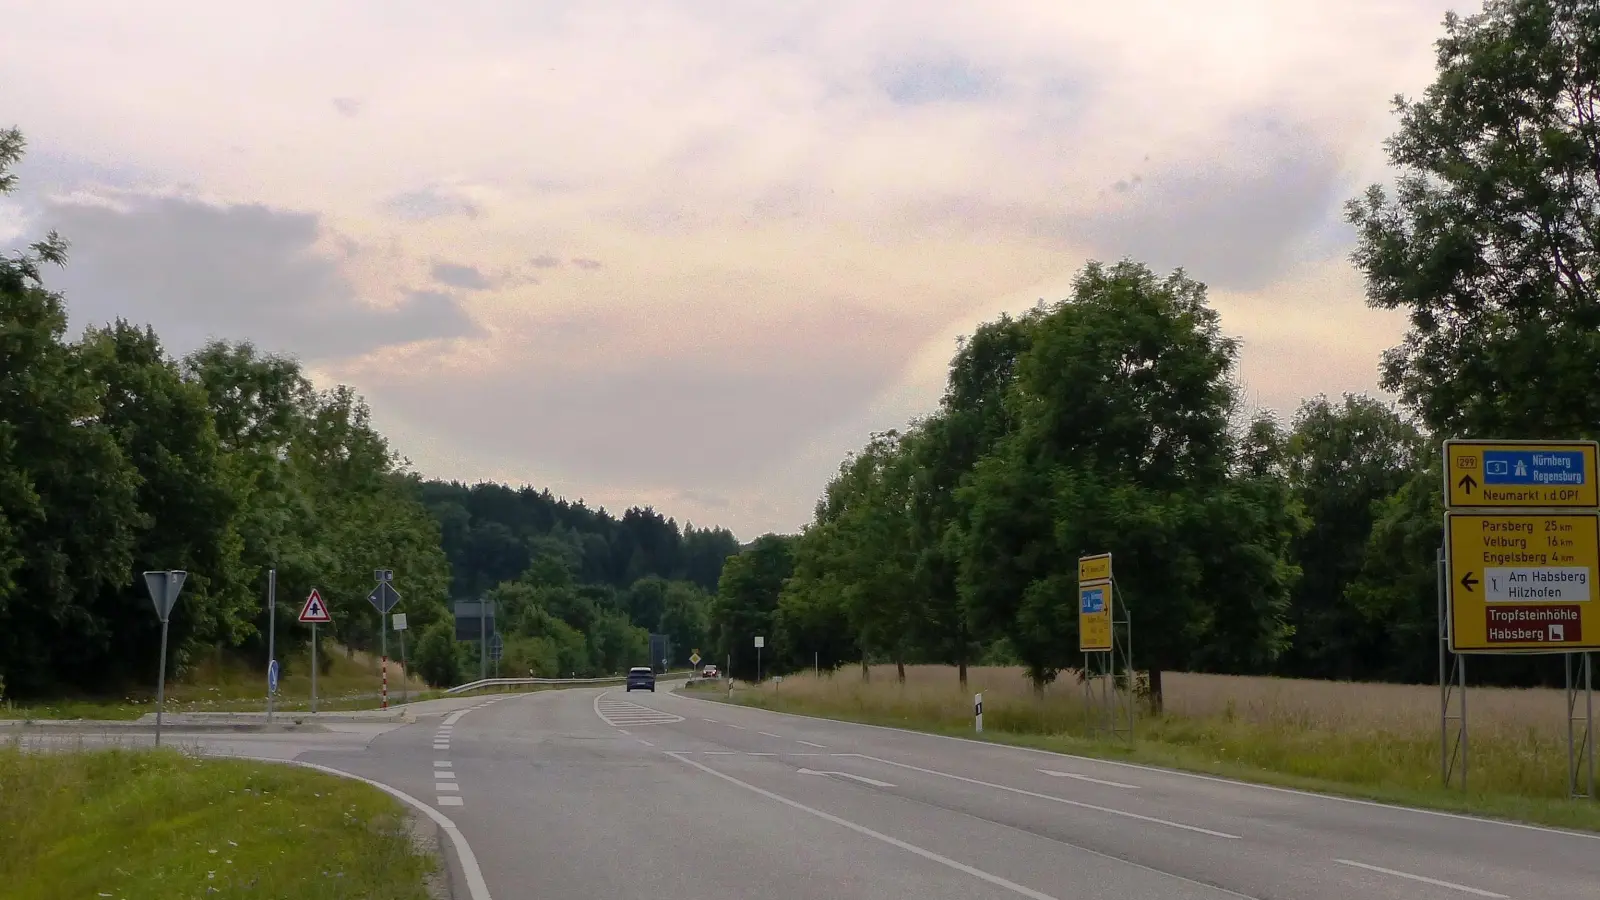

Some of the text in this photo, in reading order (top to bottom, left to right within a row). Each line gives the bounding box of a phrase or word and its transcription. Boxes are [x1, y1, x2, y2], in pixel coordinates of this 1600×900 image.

[1459, 458, 1474, 466] 299
[1532, 454, 1571, 468] Nürnberg
[1494, 464, 1500, 472] 3
[1533, 470, 1582, 484] Regensburg
[1484, 490, 1539, 500] Neumarkt
[1482, 520, 1572, 534] Parsberg 25 km
[1484, 536, 1574, 549] Velburg 16 km
[1483, 552, 1546, 564] Engelsberg
[1552, 552, 1558, 562] 4
[1508, 571, 1586, 584] Am Habsberg
[1508, 586, 1562, 598] Hilzhofen
[1489, 608, 1578, 622] Tropfsteinhöhle
[1490, 628, 1544, 641] Habsberg
